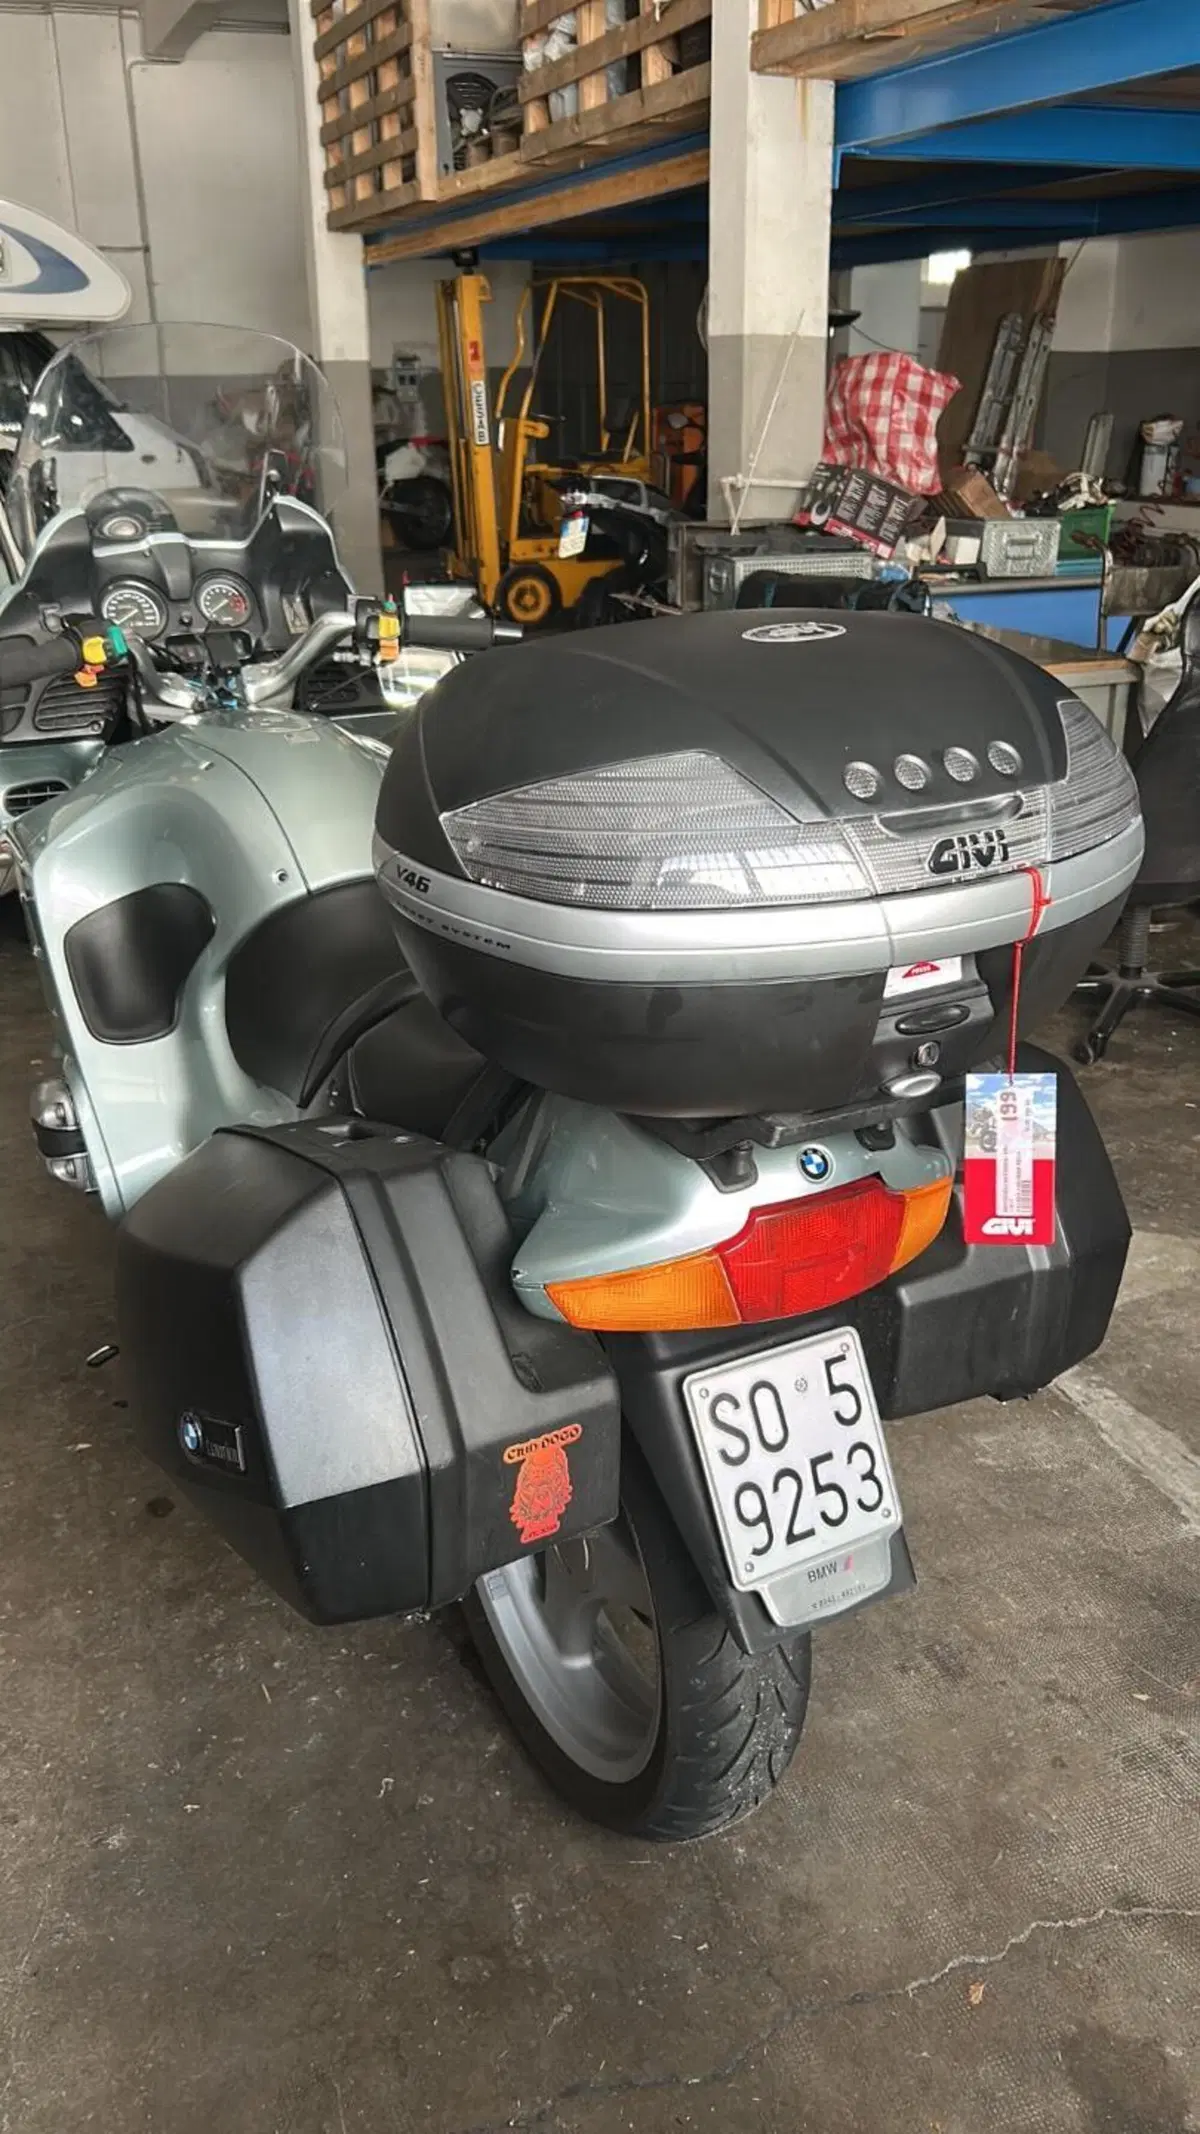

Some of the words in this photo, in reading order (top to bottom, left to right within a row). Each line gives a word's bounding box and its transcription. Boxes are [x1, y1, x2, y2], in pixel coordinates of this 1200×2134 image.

[928, 829, 1009, 875] GIVI
[396, 864, 432, 894] V46
[981, 1216, 1036, 1237] GIVI
[708, 1379, 789, 1467] SO
[823, 1353, 862, 1427] 5
[734, 1441, 884, 1557] 9253
[807, 1561, 838, 1583] BMW
